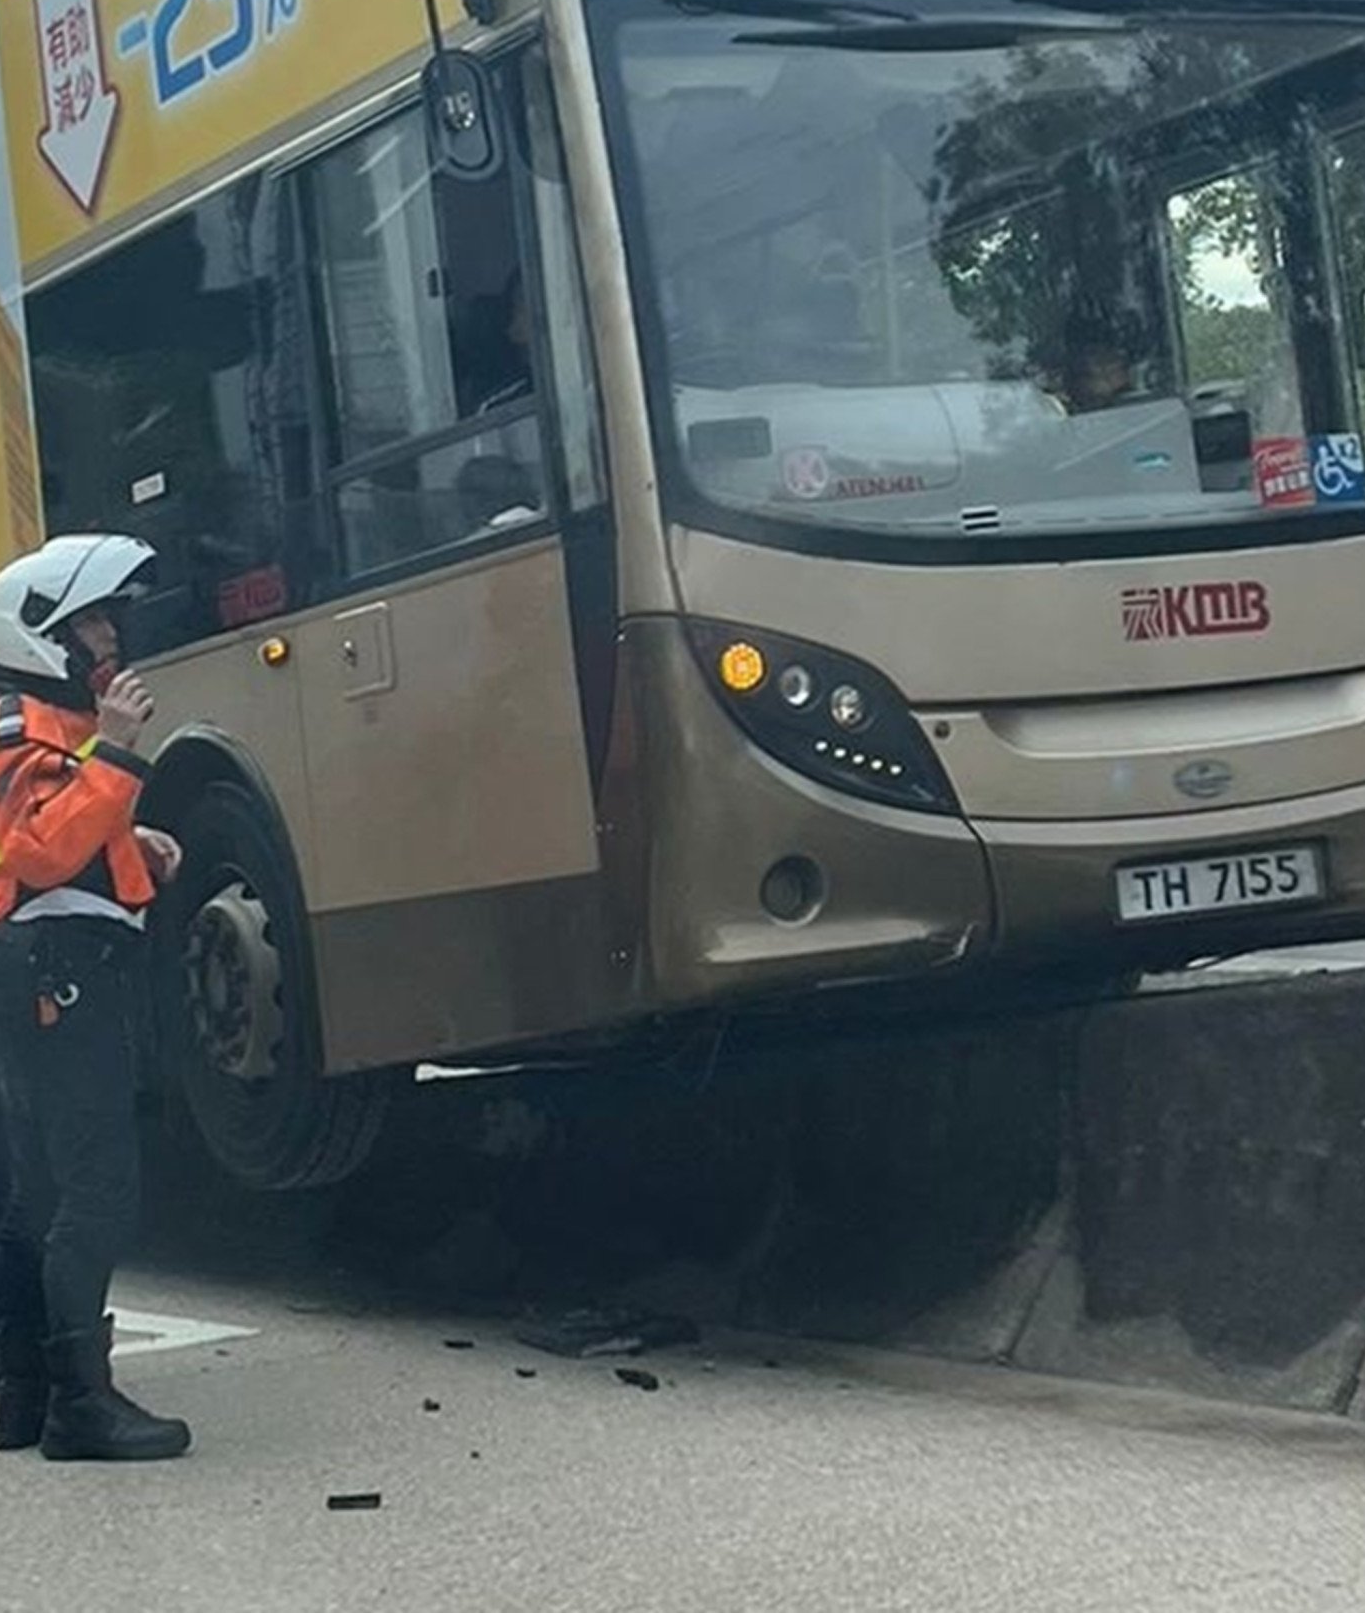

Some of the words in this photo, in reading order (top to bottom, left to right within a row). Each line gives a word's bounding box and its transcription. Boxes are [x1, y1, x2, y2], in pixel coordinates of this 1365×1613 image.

[46, 2, 90, 72] 有助
[1163, 581, 1270, 636] KMB
[1133, 867, 1190, 910] TH
[1208, 854, 1299, 903] 7155
